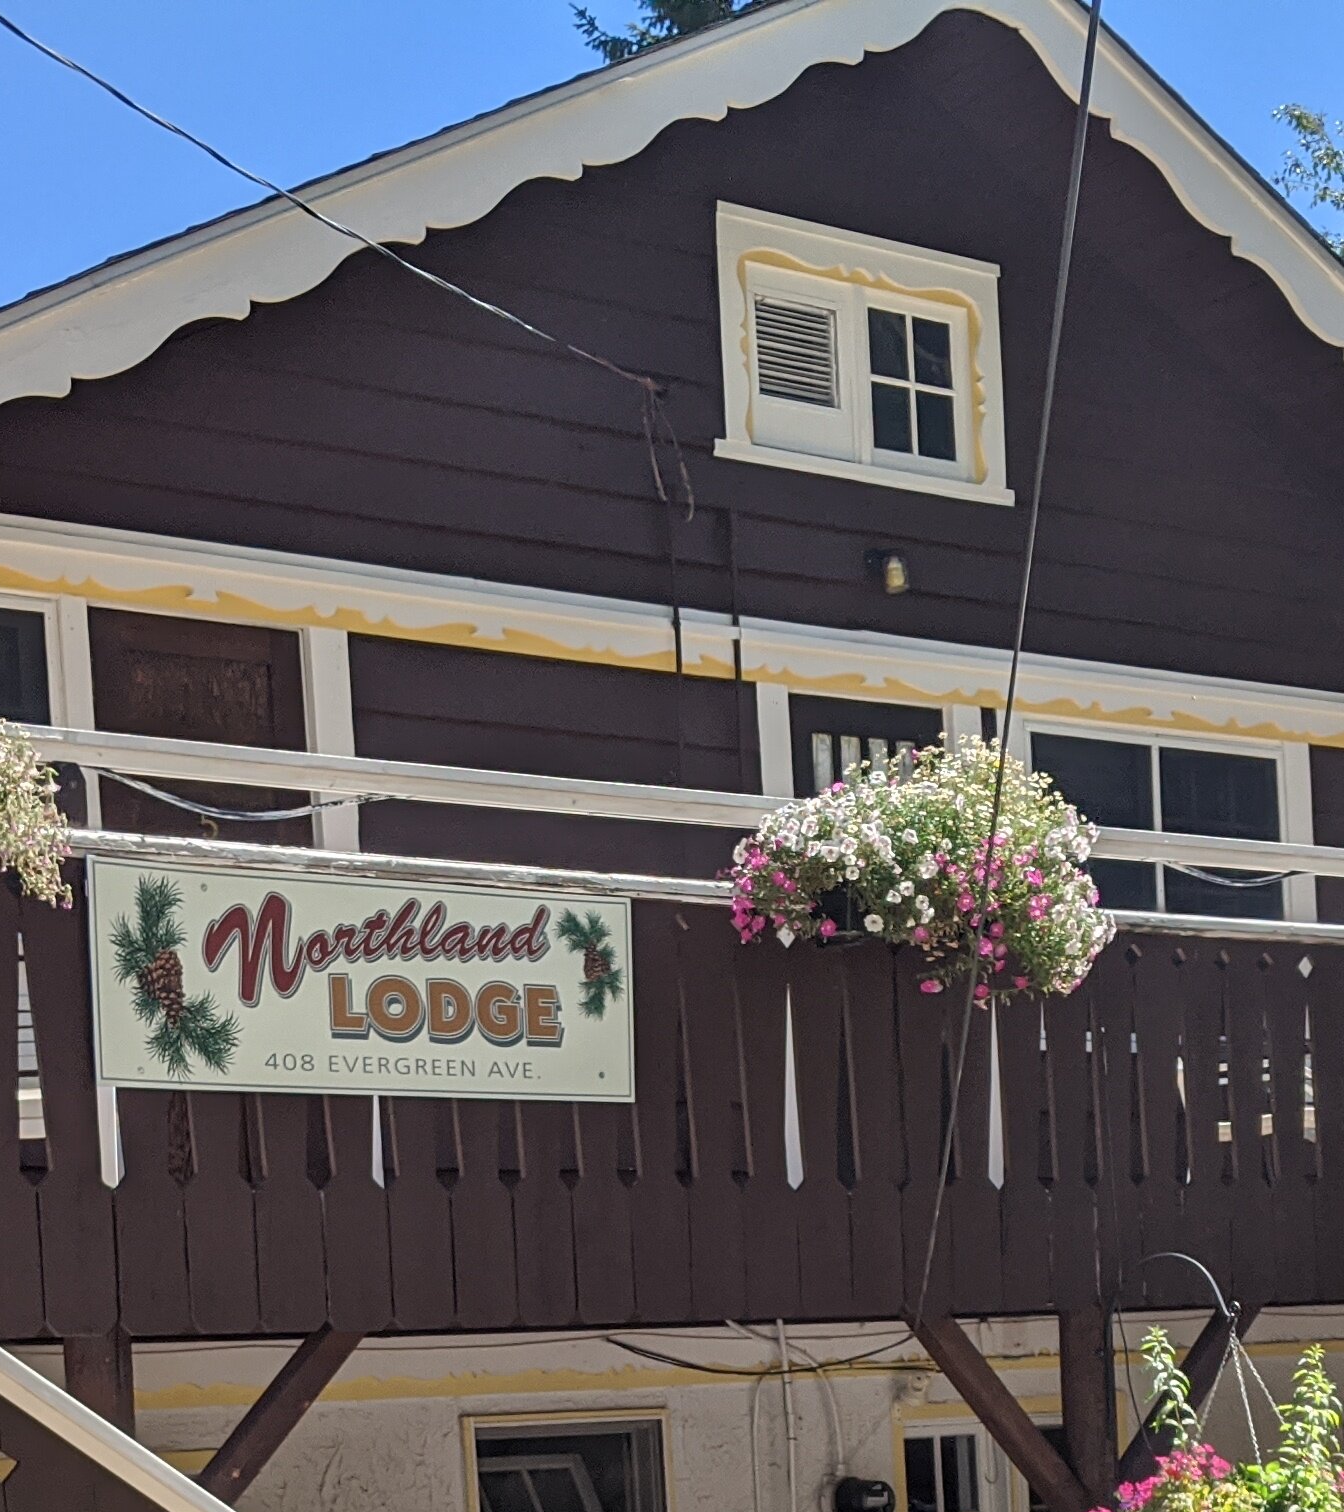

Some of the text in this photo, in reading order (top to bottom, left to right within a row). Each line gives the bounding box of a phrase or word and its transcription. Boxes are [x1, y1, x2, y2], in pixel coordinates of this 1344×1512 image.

[202, 891, 551, 1008] Northland
[328, 973, 565, 1048] LODGE
[264, 1053, 542, 1080] 408 EVERGREEN AVE.
